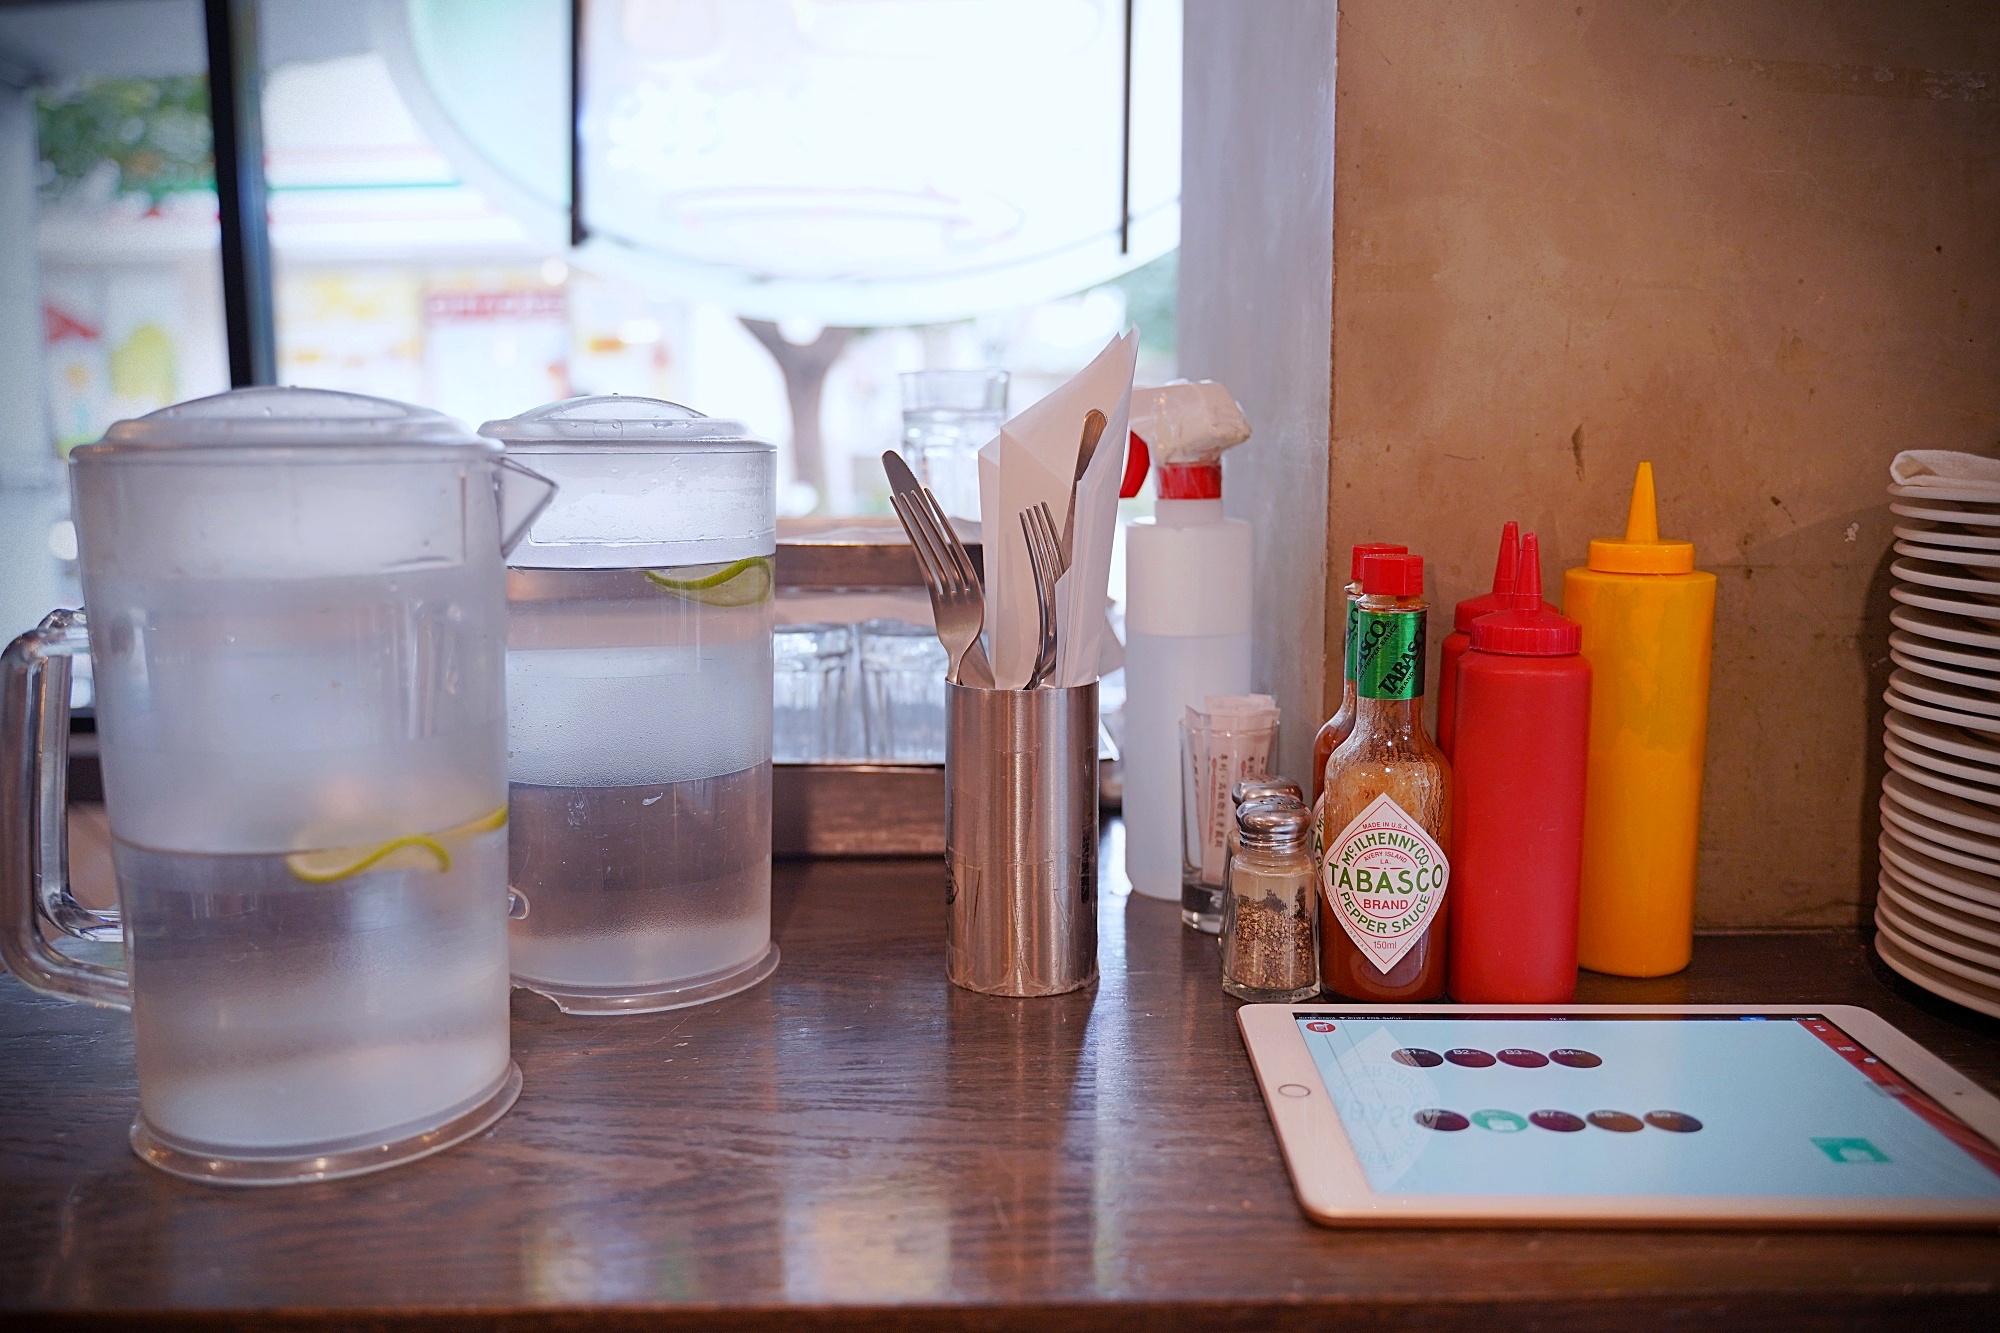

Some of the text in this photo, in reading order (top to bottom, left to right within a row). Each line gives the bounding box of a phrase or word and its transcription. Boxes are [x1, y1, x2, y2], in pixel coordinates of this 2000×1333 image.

[1364, 623, 1399, 670] PEPPER SAUCE
[1362, 822, 1382, 830] MADE
[1364, 851, 1408, 863] AVERY ISLAND
[1328, 862, 1443, 895] TABASCO
[1363, 898, 1409, 910] BRAND
[1340, 891, 1431, 934] PEPPER SAUCE
[1372, 940, 1398, 950] 150ml
